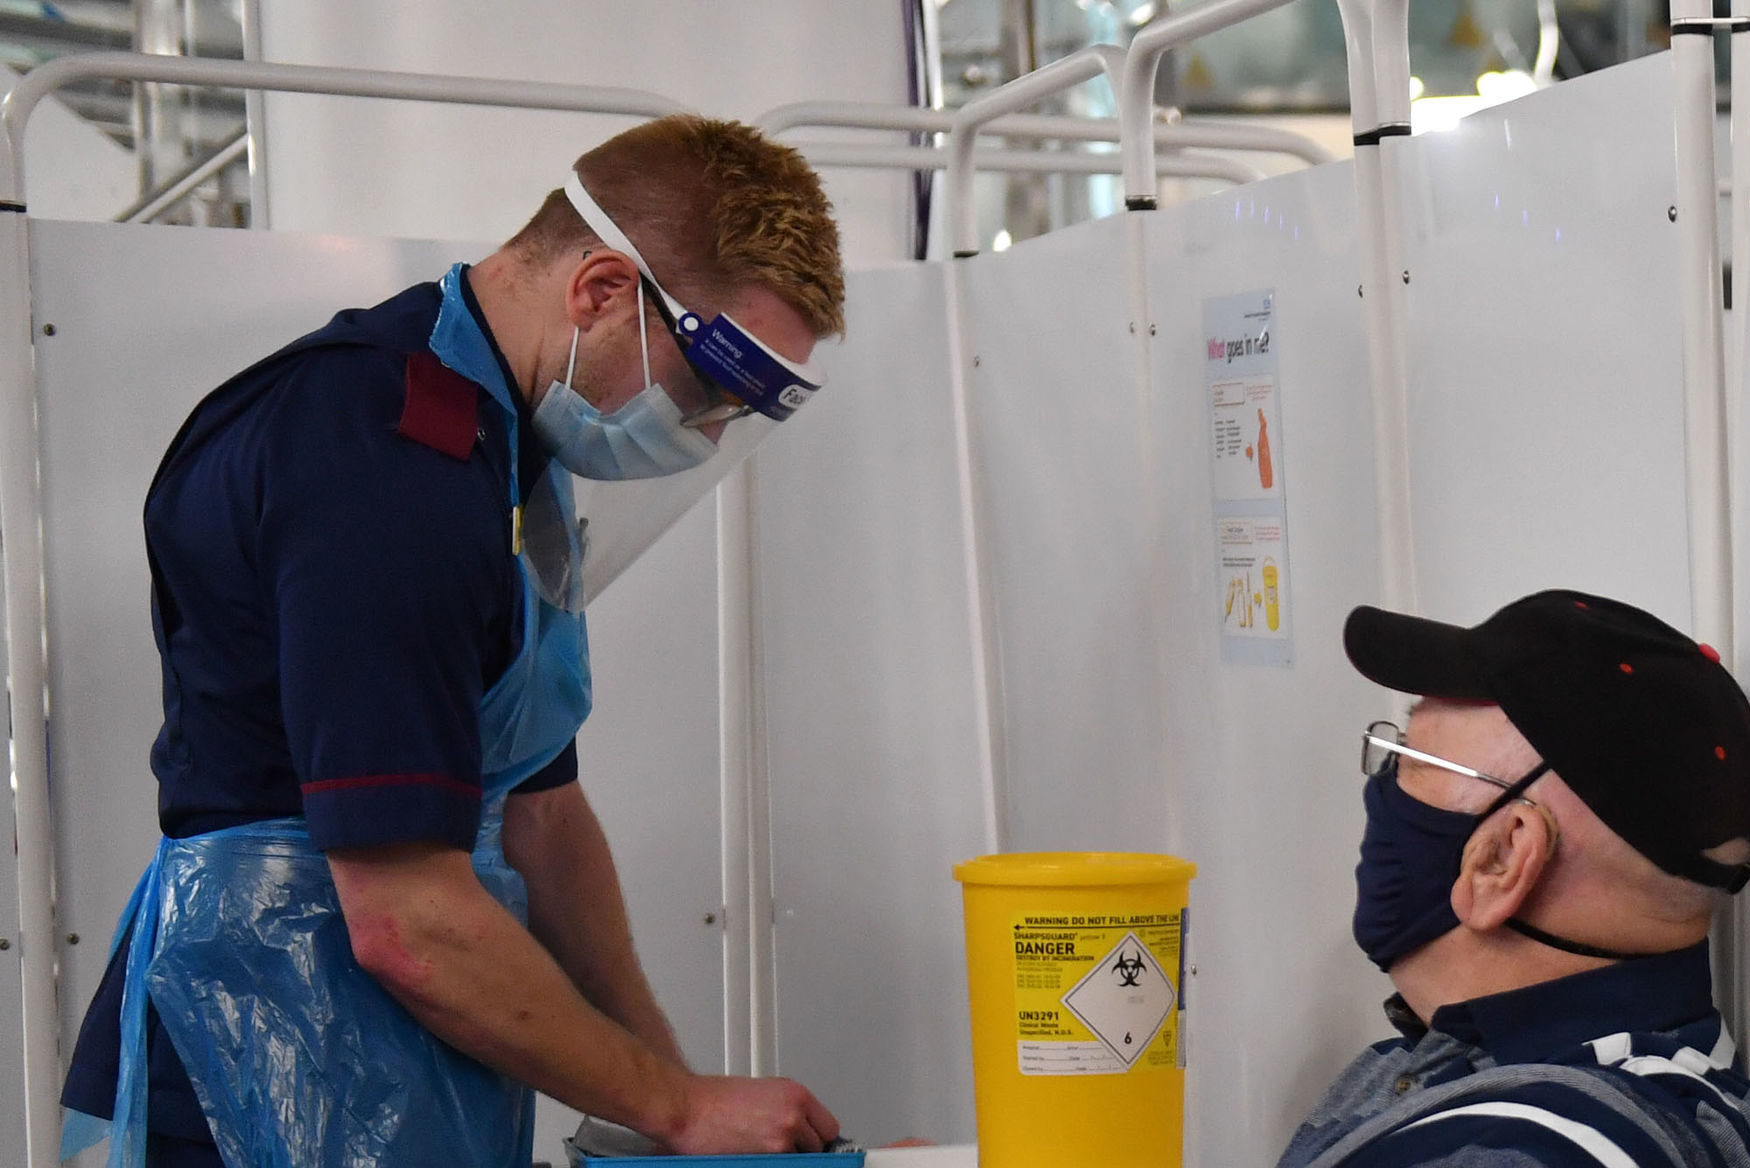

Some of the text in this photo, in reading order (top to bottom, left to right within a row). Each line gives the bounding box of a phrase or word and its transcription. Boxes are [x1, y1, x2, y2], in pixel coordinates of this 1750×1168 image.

[1227, 339, 1244, 364] goes
[1245, 333, 1252, 355] in
[1025, 916, 1069, 925] WARNING
[1072, 916, 1085, 925] DO
[1088, 916, 1106, 925] NOT
[1109, 915, 1127, 924] FILL
[1130, 915, 1155, 924] ABOVE
[1016, 942, 1075, 955] DANGER
[1019, 1011, 1059, 1021] UN3291
[1124, 1032, 1132, 1044] 6
